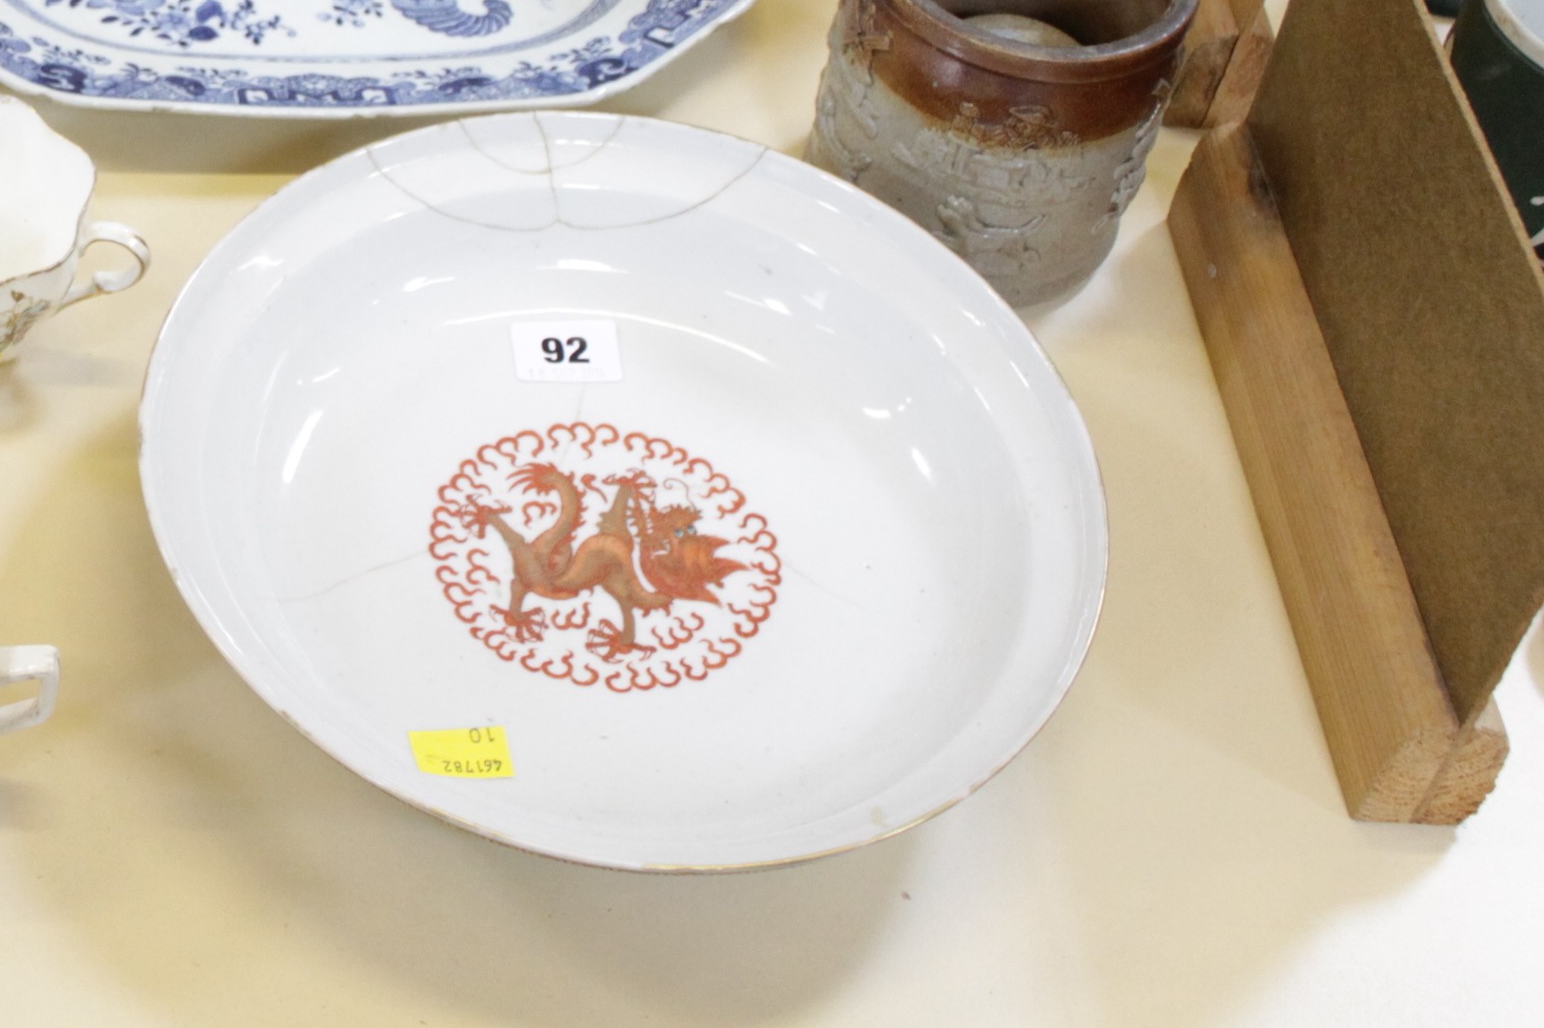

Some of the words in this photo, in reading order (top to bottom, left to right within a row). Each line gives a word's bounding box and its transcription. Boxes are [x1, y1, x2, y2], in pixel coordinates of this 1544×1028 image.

[541, 336, 590, 364] 92
[468, 727, 496, 744] 10
[442, 759, 503, 774] 461782
